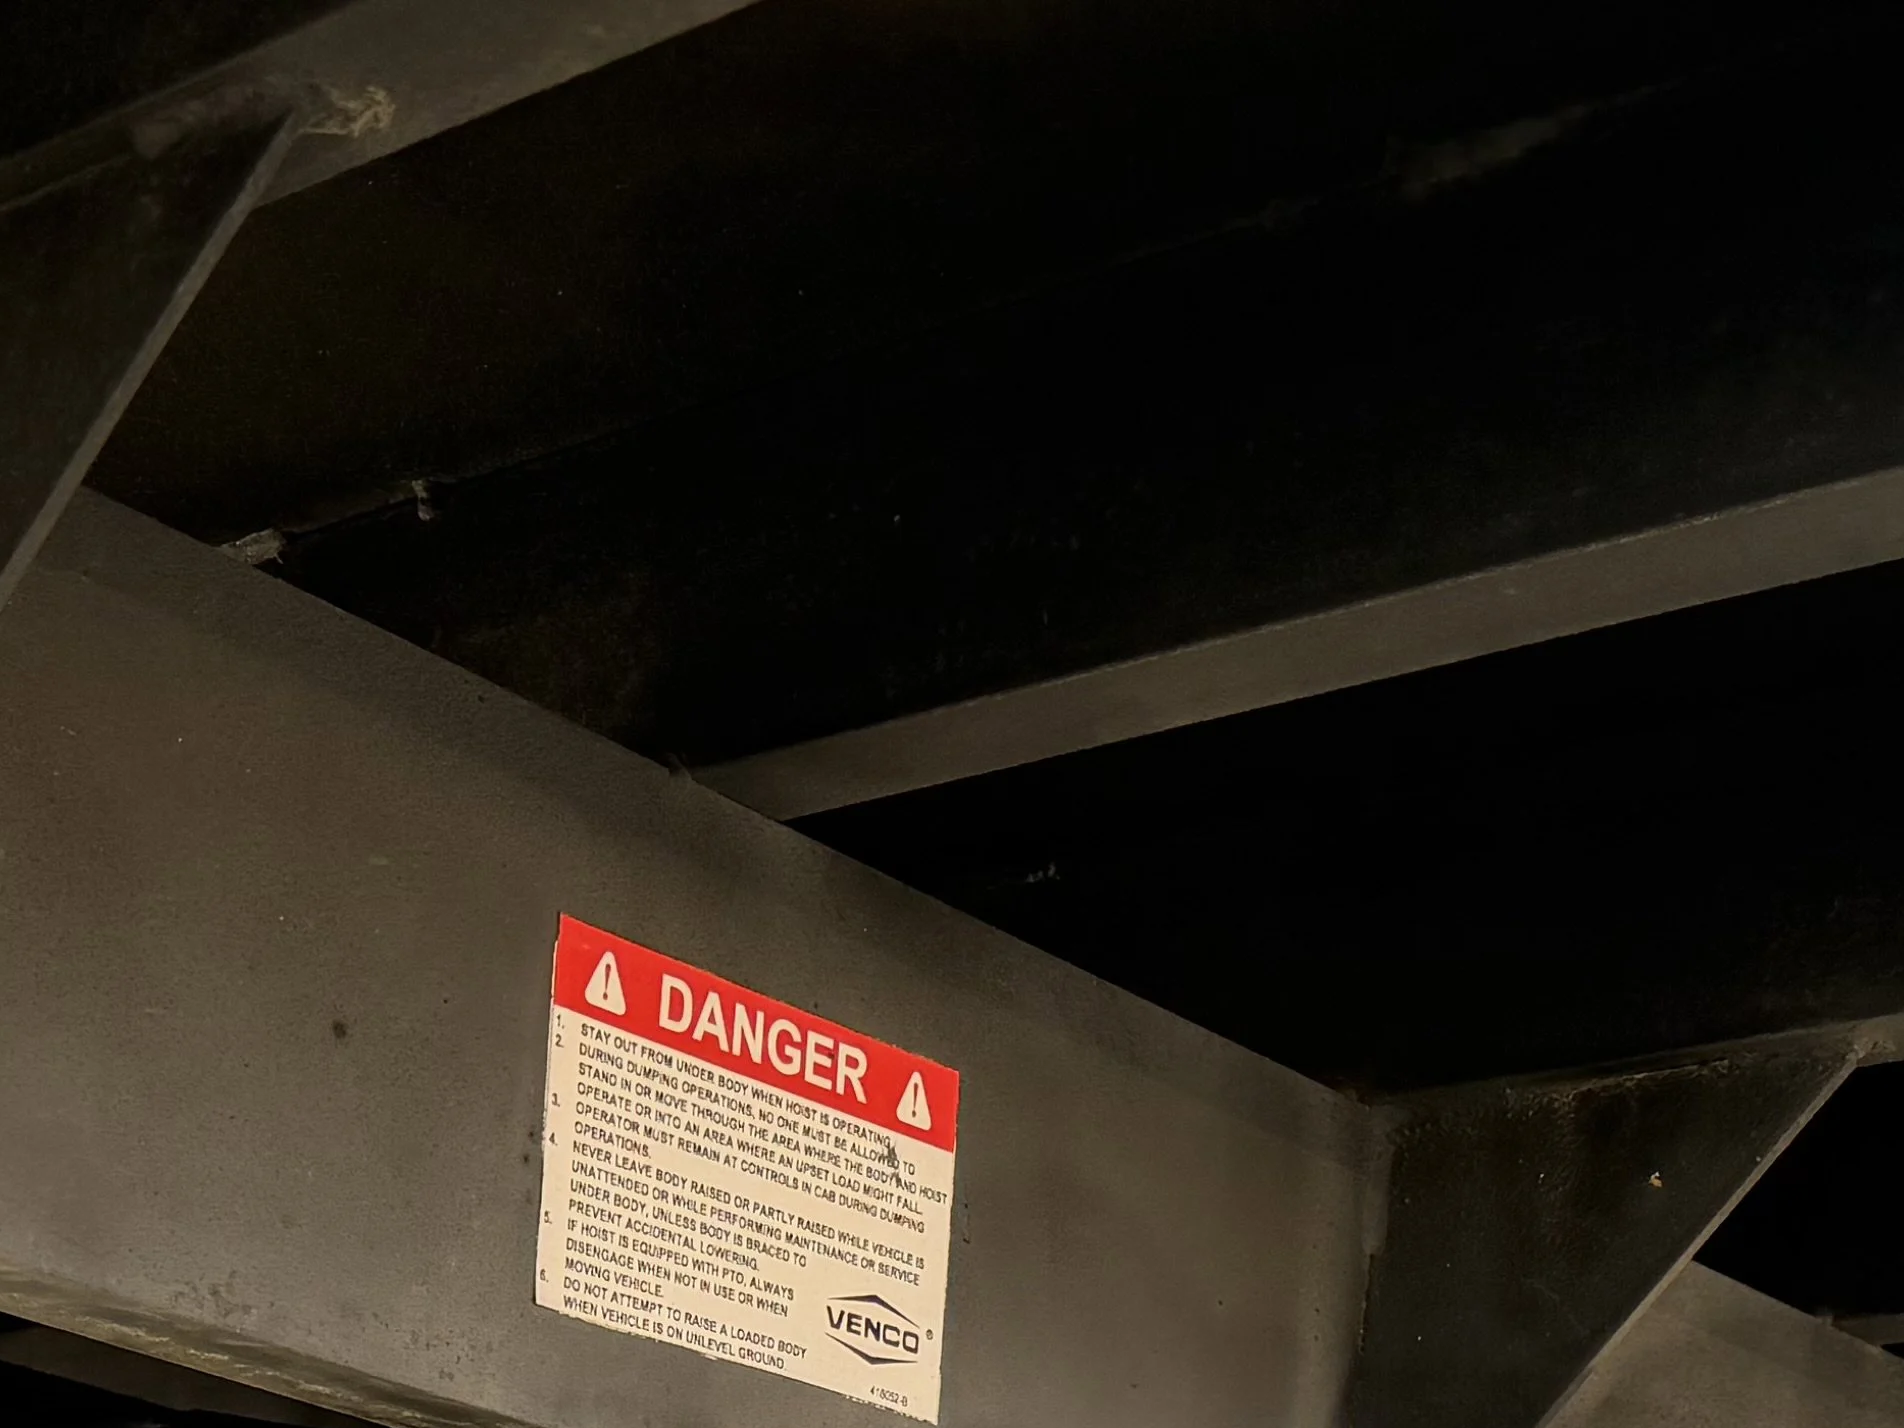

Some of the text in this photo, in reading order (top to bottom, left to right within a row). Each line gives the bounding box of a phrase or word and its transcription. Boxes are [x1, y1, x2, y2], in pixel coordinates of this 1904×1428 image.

[581, 1023, 610, 1045] STAY
[614, 1036, 636, 1055] OUT
[641, 1046, 672, 1068] FROM
[676, 1059, 714, 1084] UNDER
[718, 1074, 747, 1096] BODY
[751, 1087, 782, 1109] WHEN
[786, 1100, 816, 1121] HOIST
[820, 1112, 829, 1126] IS
[658, 971, 870, 1105] DANGER
[574, 1120, 651, 1158] OPERATIONS.
[577, 1081, 631, 1112] OPERATE
[635, 1102, 651, 1119] OR
[655, 1109, 680, 1129] INTO
[684, 1120, 699, 1136] AN
[703, 1126, 733, 1148] AREA
[736, 1138, 775, 1163] WHERE
[778, 1153, 792, 1169] AN
[796, 1159, 828, 1182] UPSET
[832, 1172, 860, 1193] LOAD
[863, 1183, 893, 1205] MIGHT
[578, 1062, 616, 1087] STAND
[620, 1077, 631, 1092] IN
[635, 1082, 651, 1099] OR
[655, 1090, 687, 1112] MOVE
[690, 1103, 744, 1133] THROUGH
[748, 1123, 768, 1141] THE
[771, 1132, 800, 1153] AREA
[804, 1143, 841, 1167] WHERE
[843, 1158, 862, 1175] THE
[866, 1166, 893, 1186] BODY
[919, 1185, 946, 1205] HOIST
[579, 1042, 622, 1070] DURING
[627, 1060, 677, 1090] DUMPING
[681, 1080, 754, 1119] OPERATIONS,
[758, 1108, 773, 1124] NO
[777, 1115, 798, 1134] ONE
[802, 1124, 830, 1145] MUST
[834, 1136, 847, 1151] BE
[903, 1161, 914, 1176] TO
[573, 1139, 611, 1164] NEVER
[615, 1154, 651, 1178] LEAVE
[656, 1168, 686, 1190] BODY
[690, 1180, 730, 1205] RAISED
[734, 1194, 749, 1211] OR
[753, 1201, 793, 1226] PARTLY
[797, 1216, 834, 1240] RAISED
[837, 1230, 868, 1252] WHILE
[872, 1242, 912, 1266] VEHICLE
[915, 1257, 924, 1270] IS
[576, 1101, 639, 1134] OPERATOR
[643, 1125, 673, 1146] MUST
[677, 1137, 719, 1162] REMAIN
[724, 1153, 736, 1168] AT
[740, 1159, 798, 1190] CONTROLS
[801, 1180, 811, 1194] IN
[814, 1185, 835, 1203] CAB
[839, 1193, 876, 1217] DURING
[880, 1208, 923, 1234] DUMPING
[567, 1217, 577, 1232] IF
[581, 1221, 614, 1244] HOIST
[618, 1233, 628, 1248] IS
[632, 1238, 688, 1267] EQUIPPED
[691, 1257, 718, 1277] WITH
[722, 1267, 746, 1288] PTO,
[749, 1276, 793, 1301] ALWAYS
[569, 1198, 759, 1271] PREVENT ACCIDENTAL LOWERING.
[570, 1178, 805, 1268] UNDER BODY, UNLESS BODY IS BRACED TO
[572, 1159, 918, 1287] UNATTENDED OR WHILE PERFORMING MAINTENANCE OR SERVICE
[565, 1256, 609, 1281] MOVING
[566, 1237, 787, 1318] DISENGAGE WHEN NOT IN USE OR WHEN
[563, 1294, 597, 1316] WHEN
[600, 1305, 649, 1331] VEHICLE
[652, 1321, 663, 1335] IS
[666, 1325, 682, 1341] ON
[686, 1331, 735, 1357] UNLEVEL
[564, 1275, 580, 1292] DO
[584, 1281, 607, 1300] NOT
[610, 1289, 662, 1317] ATTEMPT
[666, 1306, 680, 1322] TO
[684, 1312, 716, 1333] RAISE
[719, 1323, 727, 1337] A
[731, 1326, 774, 1351] LOADED
[777, 1341, 805, 1361] BODY
[825, 1305, 919, 1355] VENCO
